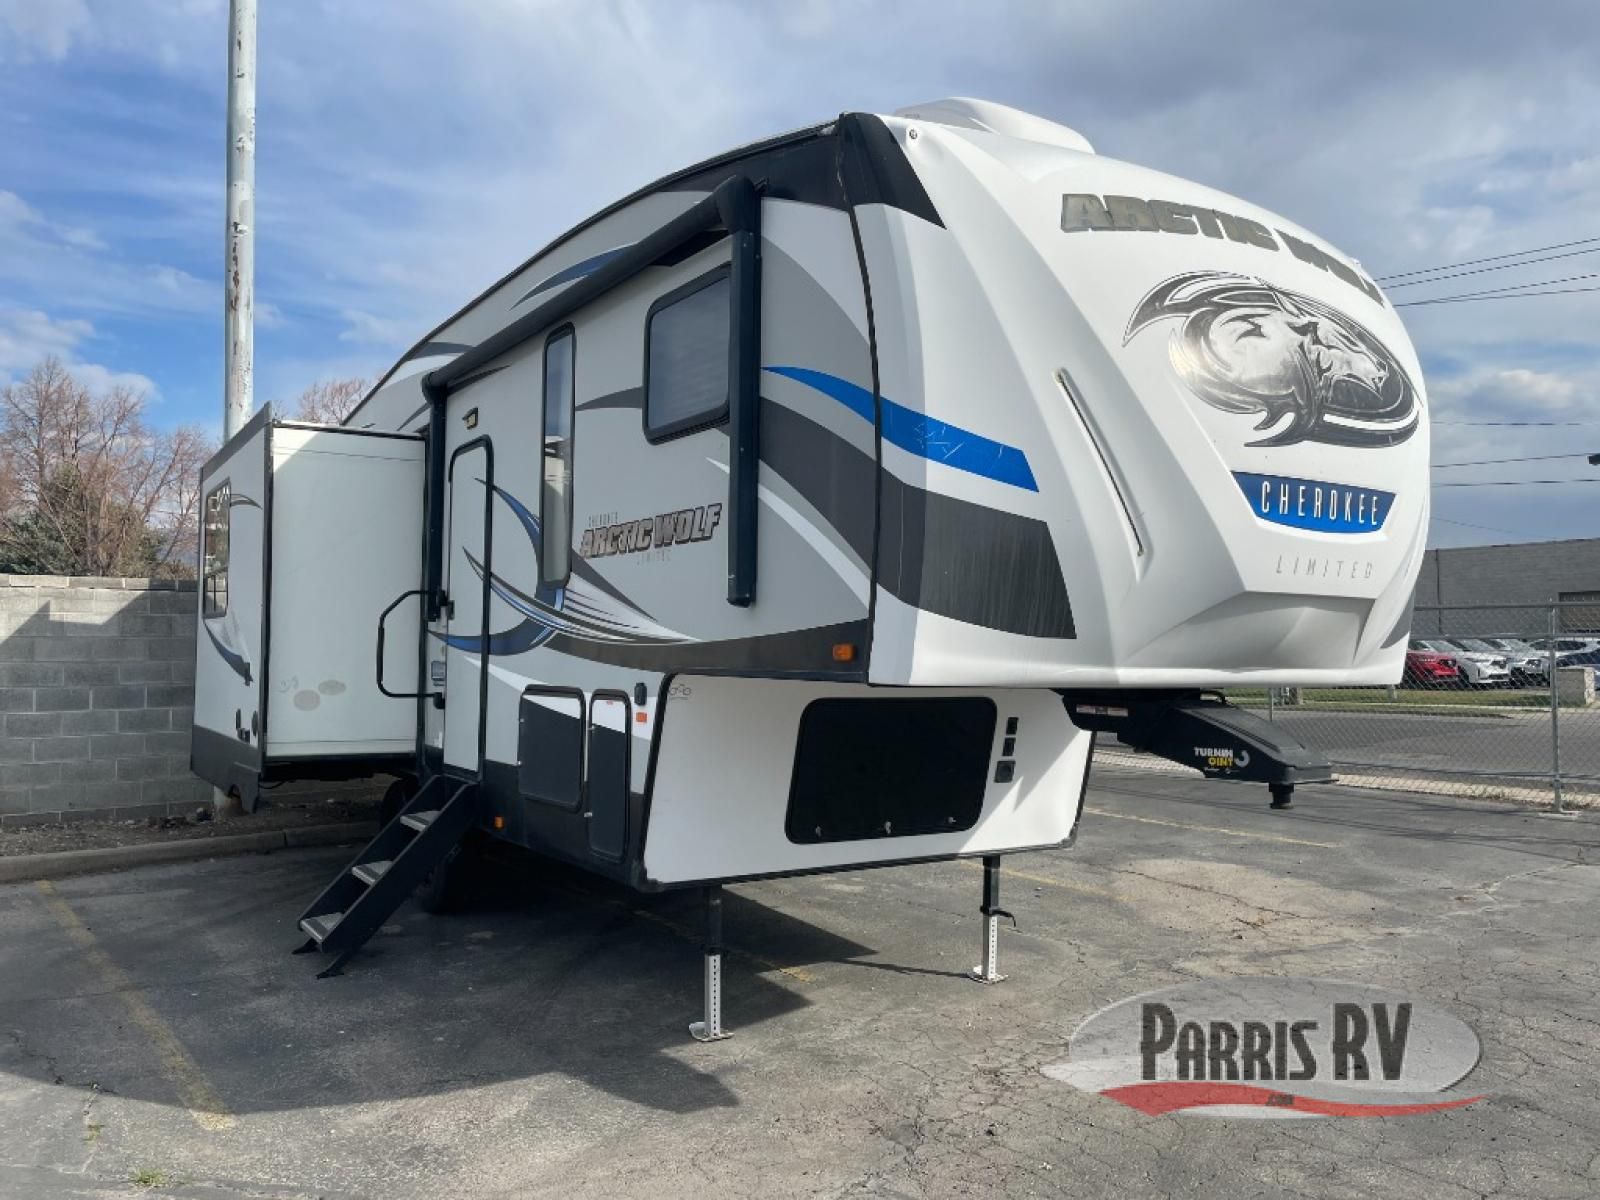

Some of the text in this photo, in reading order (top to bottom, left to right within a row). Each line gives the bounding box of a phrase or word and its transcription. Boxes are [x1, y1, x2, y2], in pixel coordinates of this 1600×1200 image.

[1061, 193, 1280, 251] ARCTIC
[1260, 479, 1379, 526] CHEROKEE
[581, 517, 654, 559] ARCTIC
[654, 502, 723, 548] WOLF
[1275, 554, 1373, 578] LIMITED
